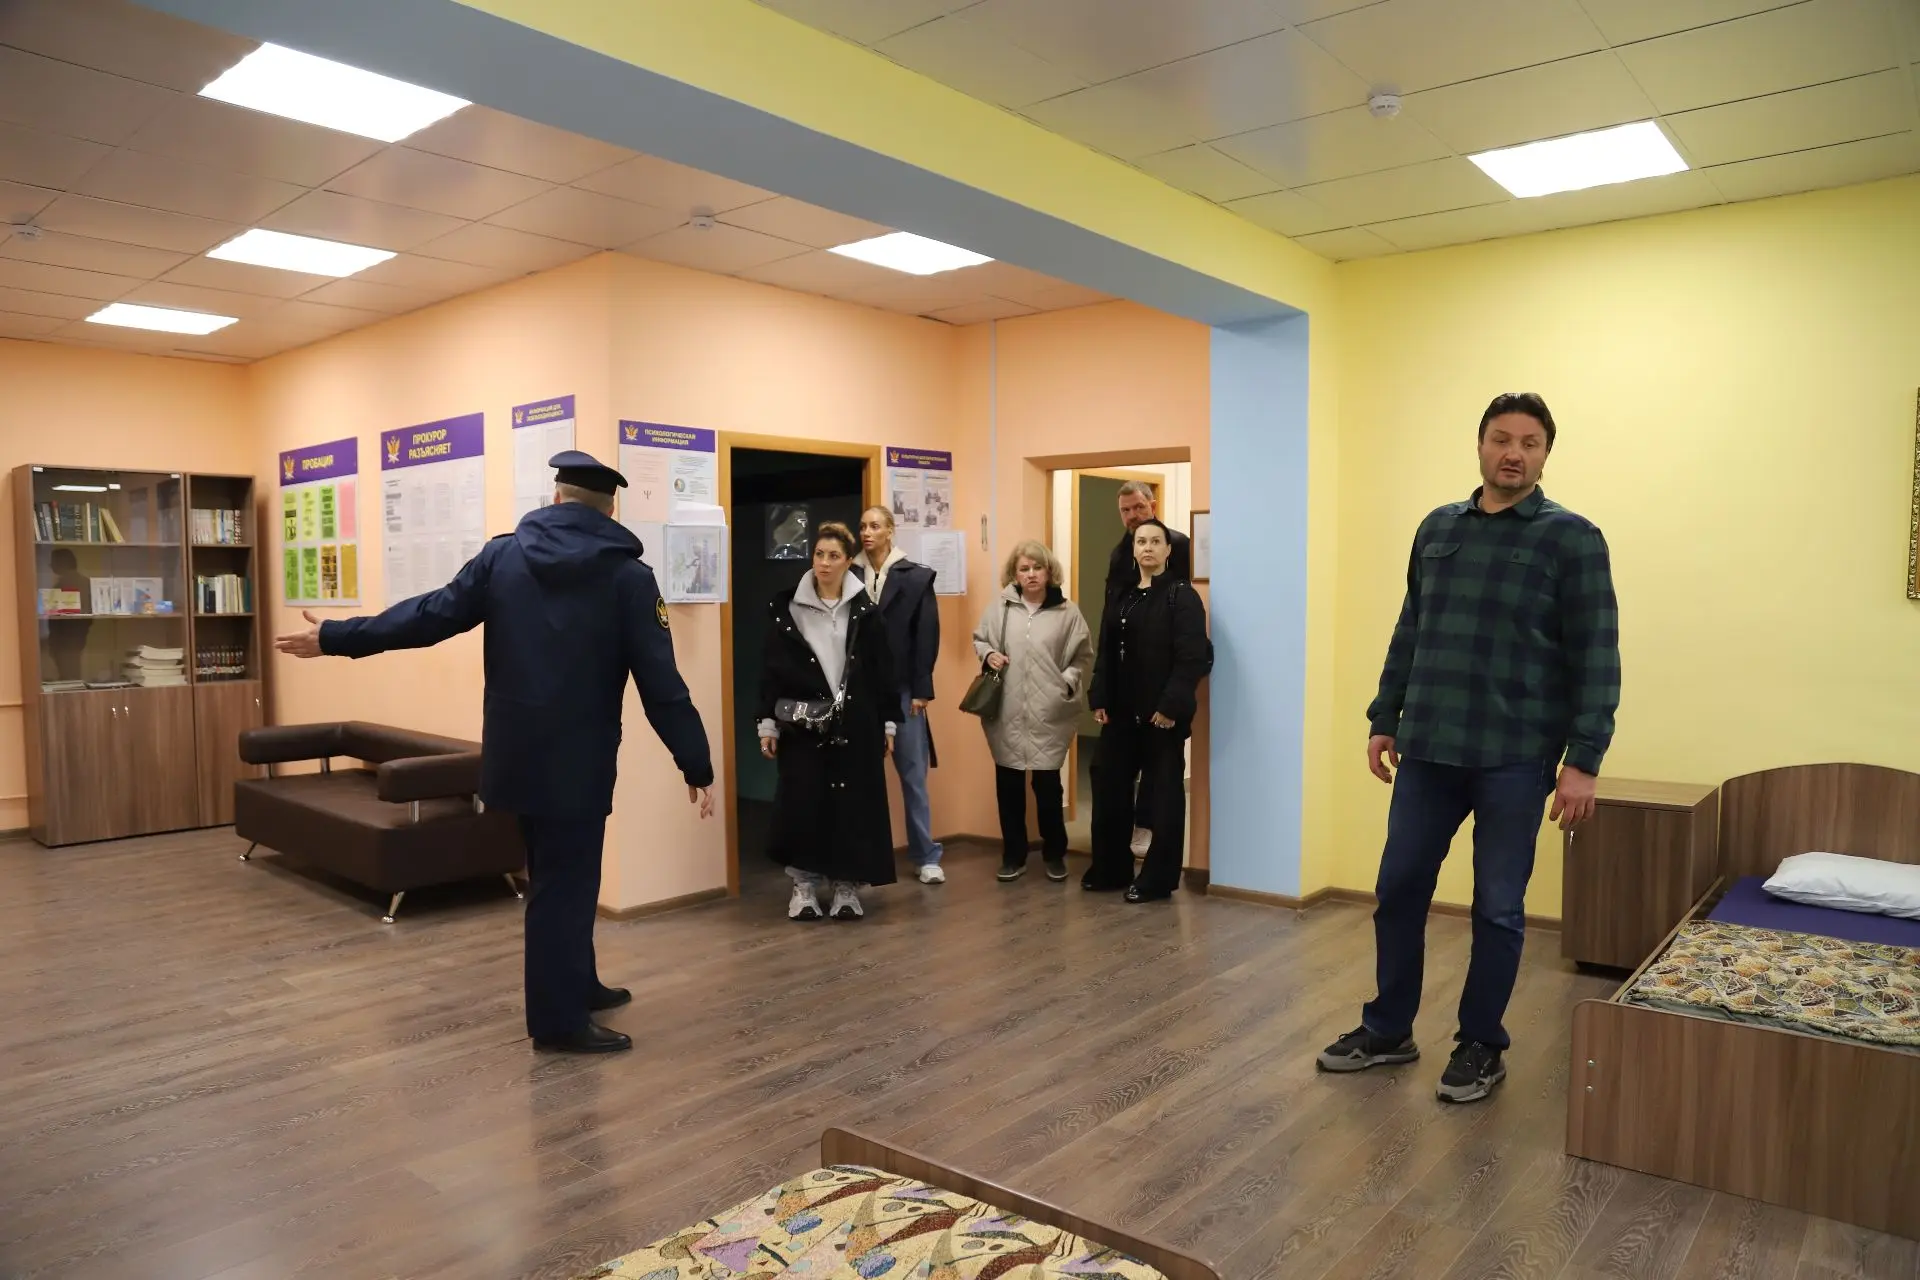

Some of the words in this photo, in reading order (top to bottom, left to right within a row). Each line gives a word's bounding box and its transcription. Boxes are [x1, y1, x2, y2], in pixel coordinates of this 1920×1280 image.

[412, 429, 447, 443] ПРОКУРОР
[644, 429, 696, 440] ПСИХОЛОГИЧЕСКАЯ
[652, 437, 689, 445] ИНФОРМАЦИЯ
[408, 443, 451, 459] РАЗЪЯСНЯЕТ
[302, 455, 334, 470] ПРОБАЦИЯ
